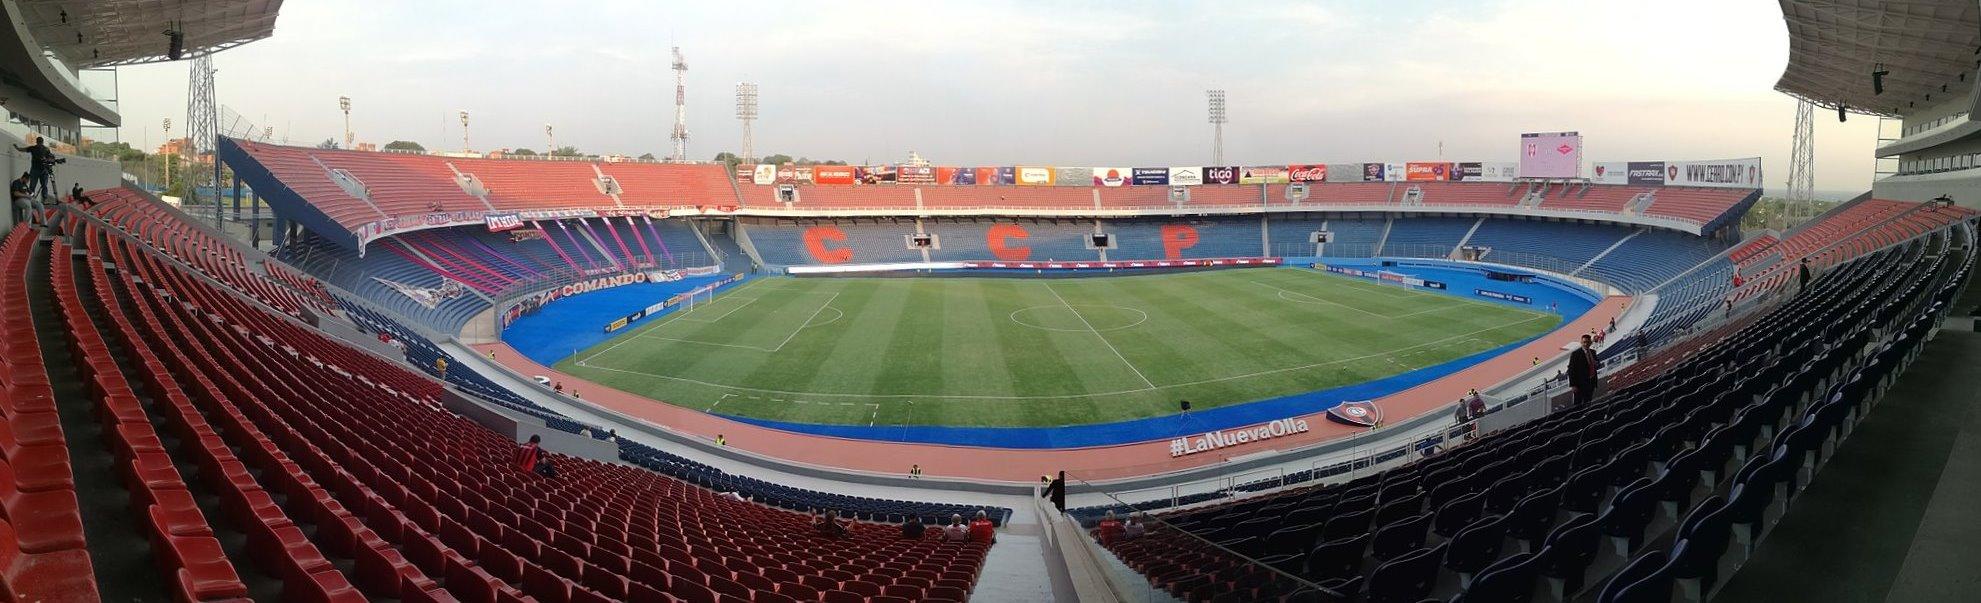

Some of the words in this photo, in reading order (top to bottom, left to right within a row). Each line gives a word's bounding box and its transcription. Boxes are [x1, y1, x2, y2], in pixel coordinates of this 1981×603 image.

[803, 225, 853, 264] C
[987, 223, 1031, 261] C
[1160, 224, 1200, 260] P
[562, 272, 646, 298] COMANDO
[1170, 417, 1309, 458] #LaNuevaOlla
